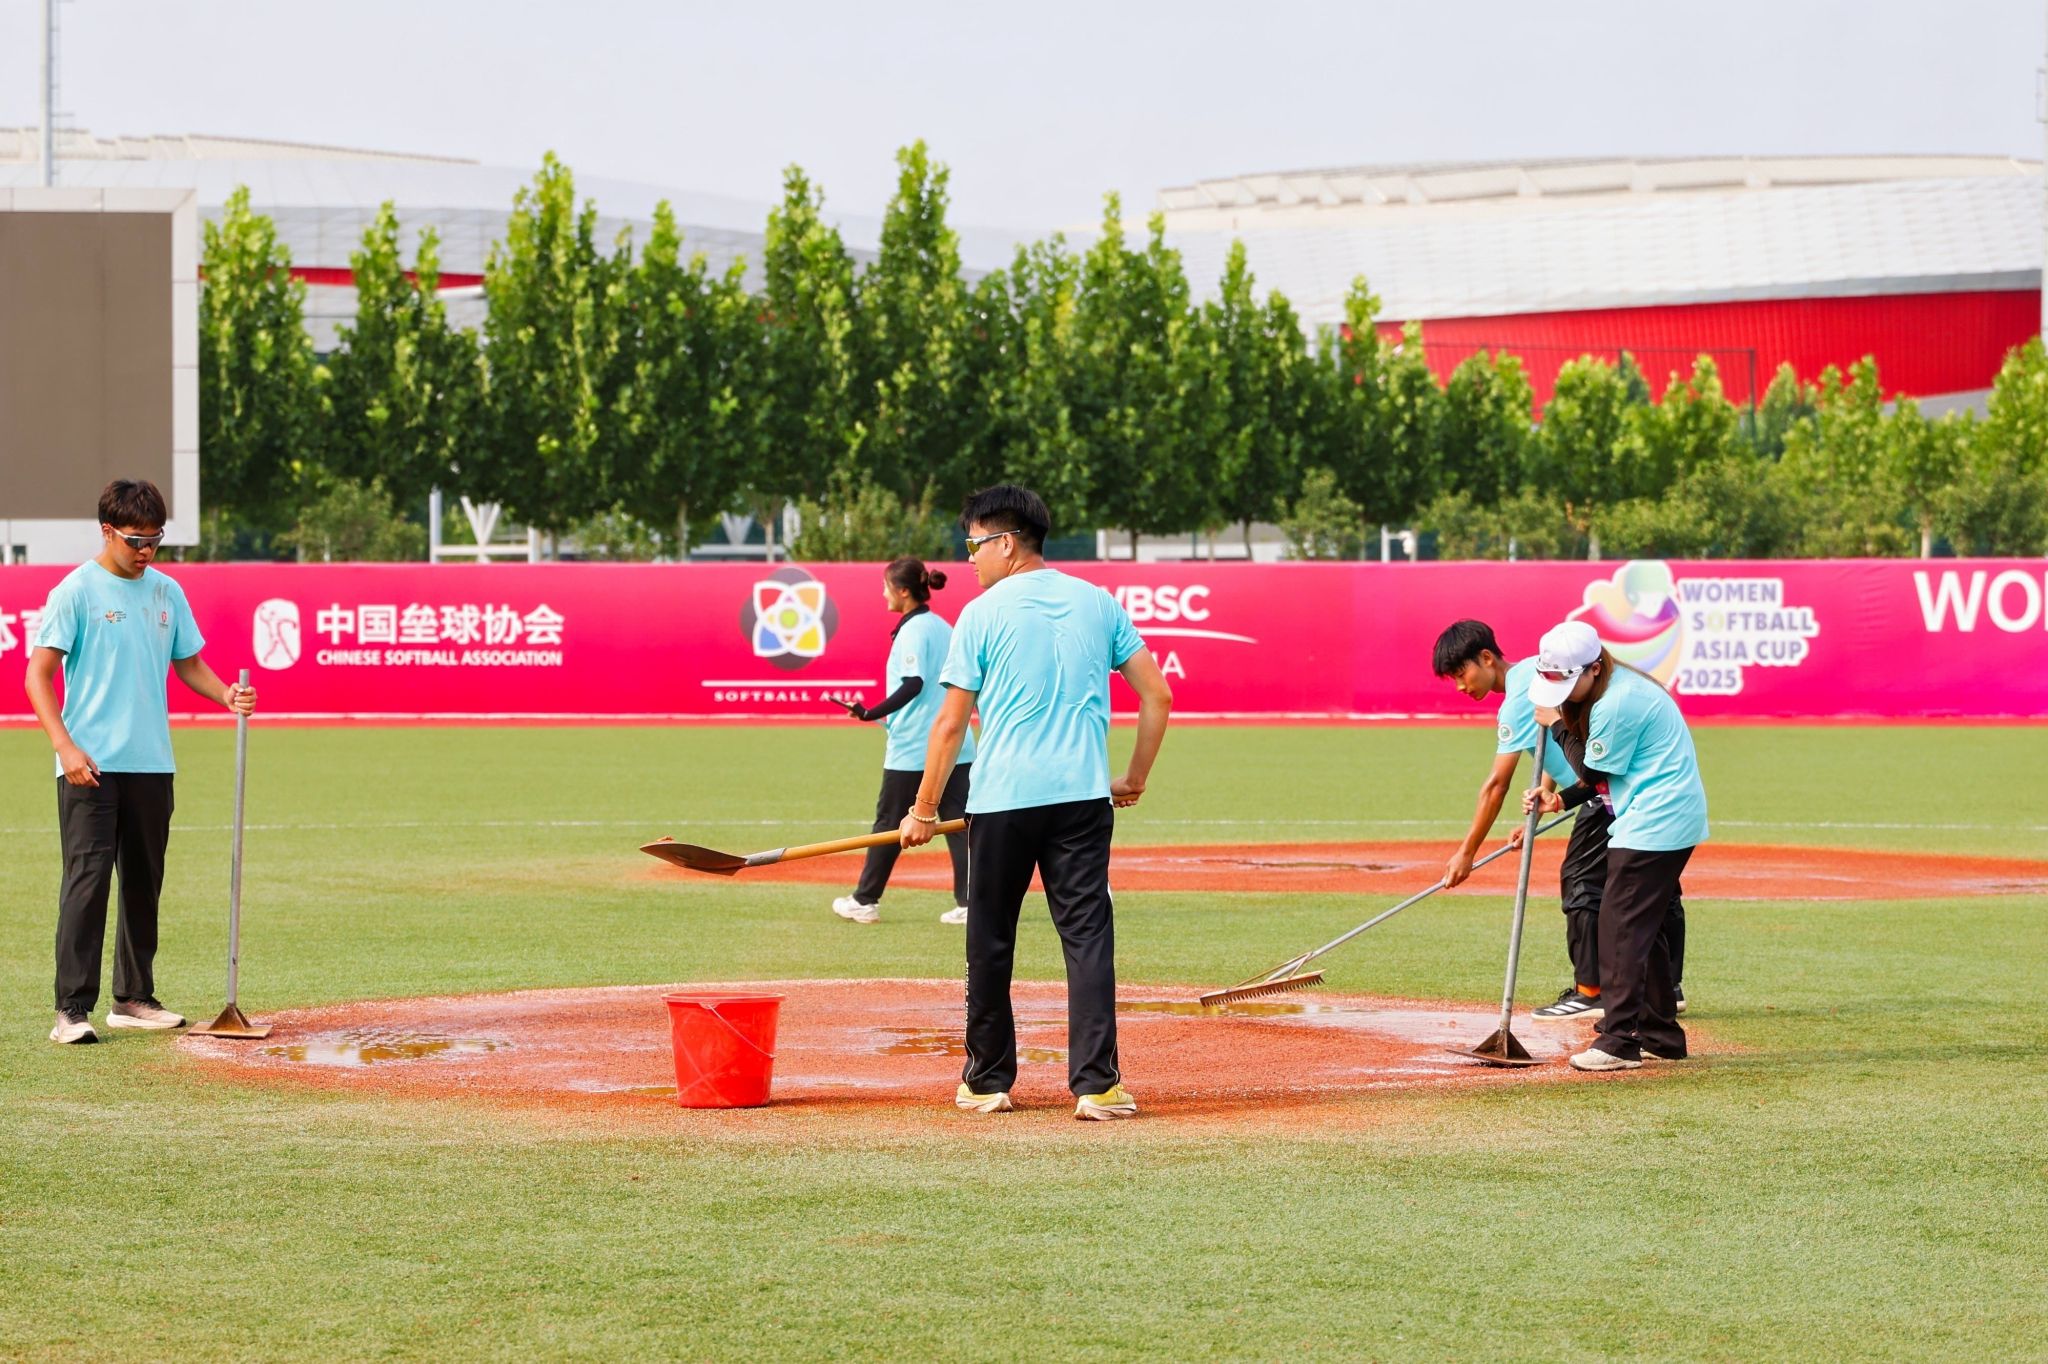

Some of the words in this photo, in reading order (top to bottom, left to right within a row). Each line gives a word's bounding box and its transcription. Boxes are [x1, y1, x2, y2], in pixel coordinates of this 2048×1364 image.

[1682, 583, 1777, 602] WOMEN
[1913, 569, 2048, 633] WO
[316, 603, 564, 645] 中国垒球协会
[1692, 611, 1813, 632] SOFTBALL
[316, 650, 382, 666] CHINESE
[384, 650, 458, 666] SOFTBALL
[461, 650, 563, 666] ASSOCIATION
[1692, 641, 1748, 660] ASIA
[1756, 641, 1802, 660] CUP
[1682, 669, 1737, 689] 2025
[714, 691, 811, 702] SOFTBALL
[819, 691, 865, 702] ASIA
